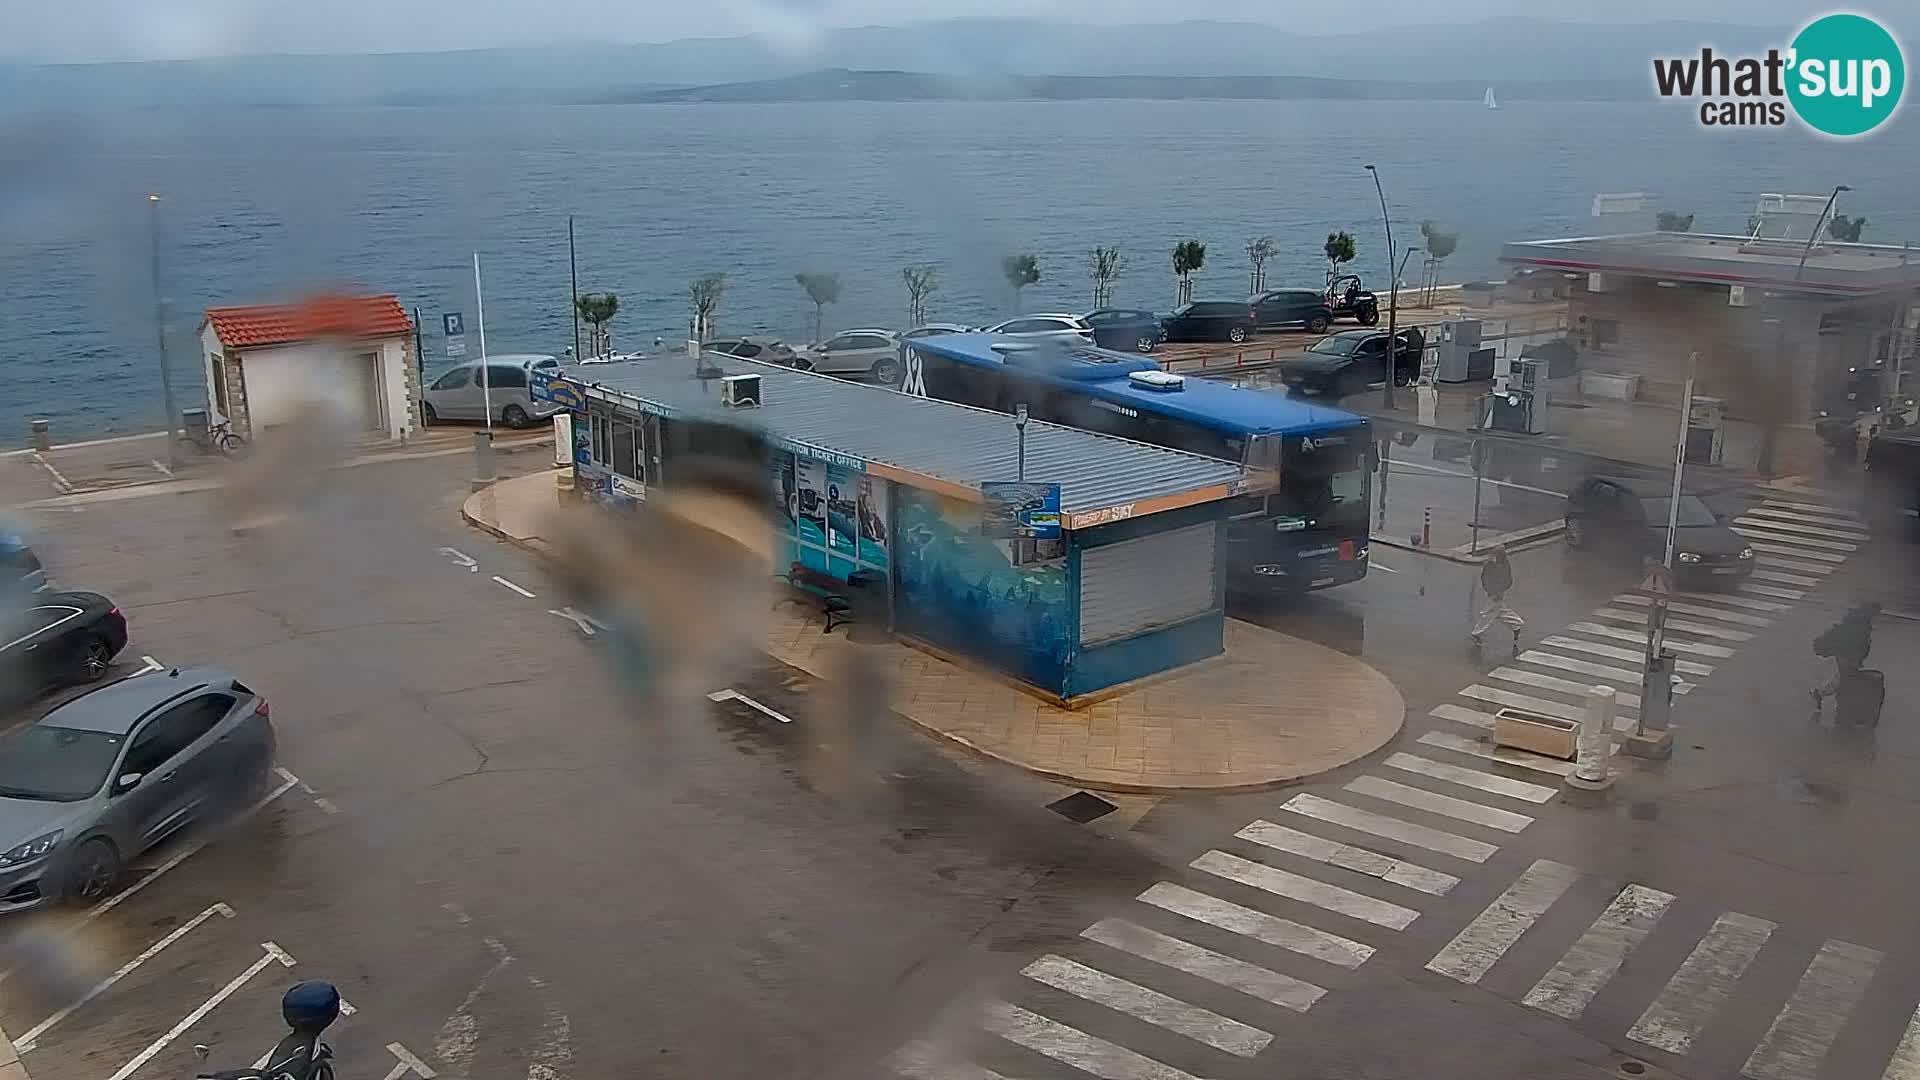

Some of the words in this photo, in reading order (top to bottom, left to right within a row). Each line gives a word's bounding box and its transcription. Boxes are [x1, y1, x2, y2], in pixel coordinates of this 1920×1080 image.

[447, 316, 458, 333] P
[811, 449, 835, 462] TICKET
[837, 456, 862, 469] OFFICE
